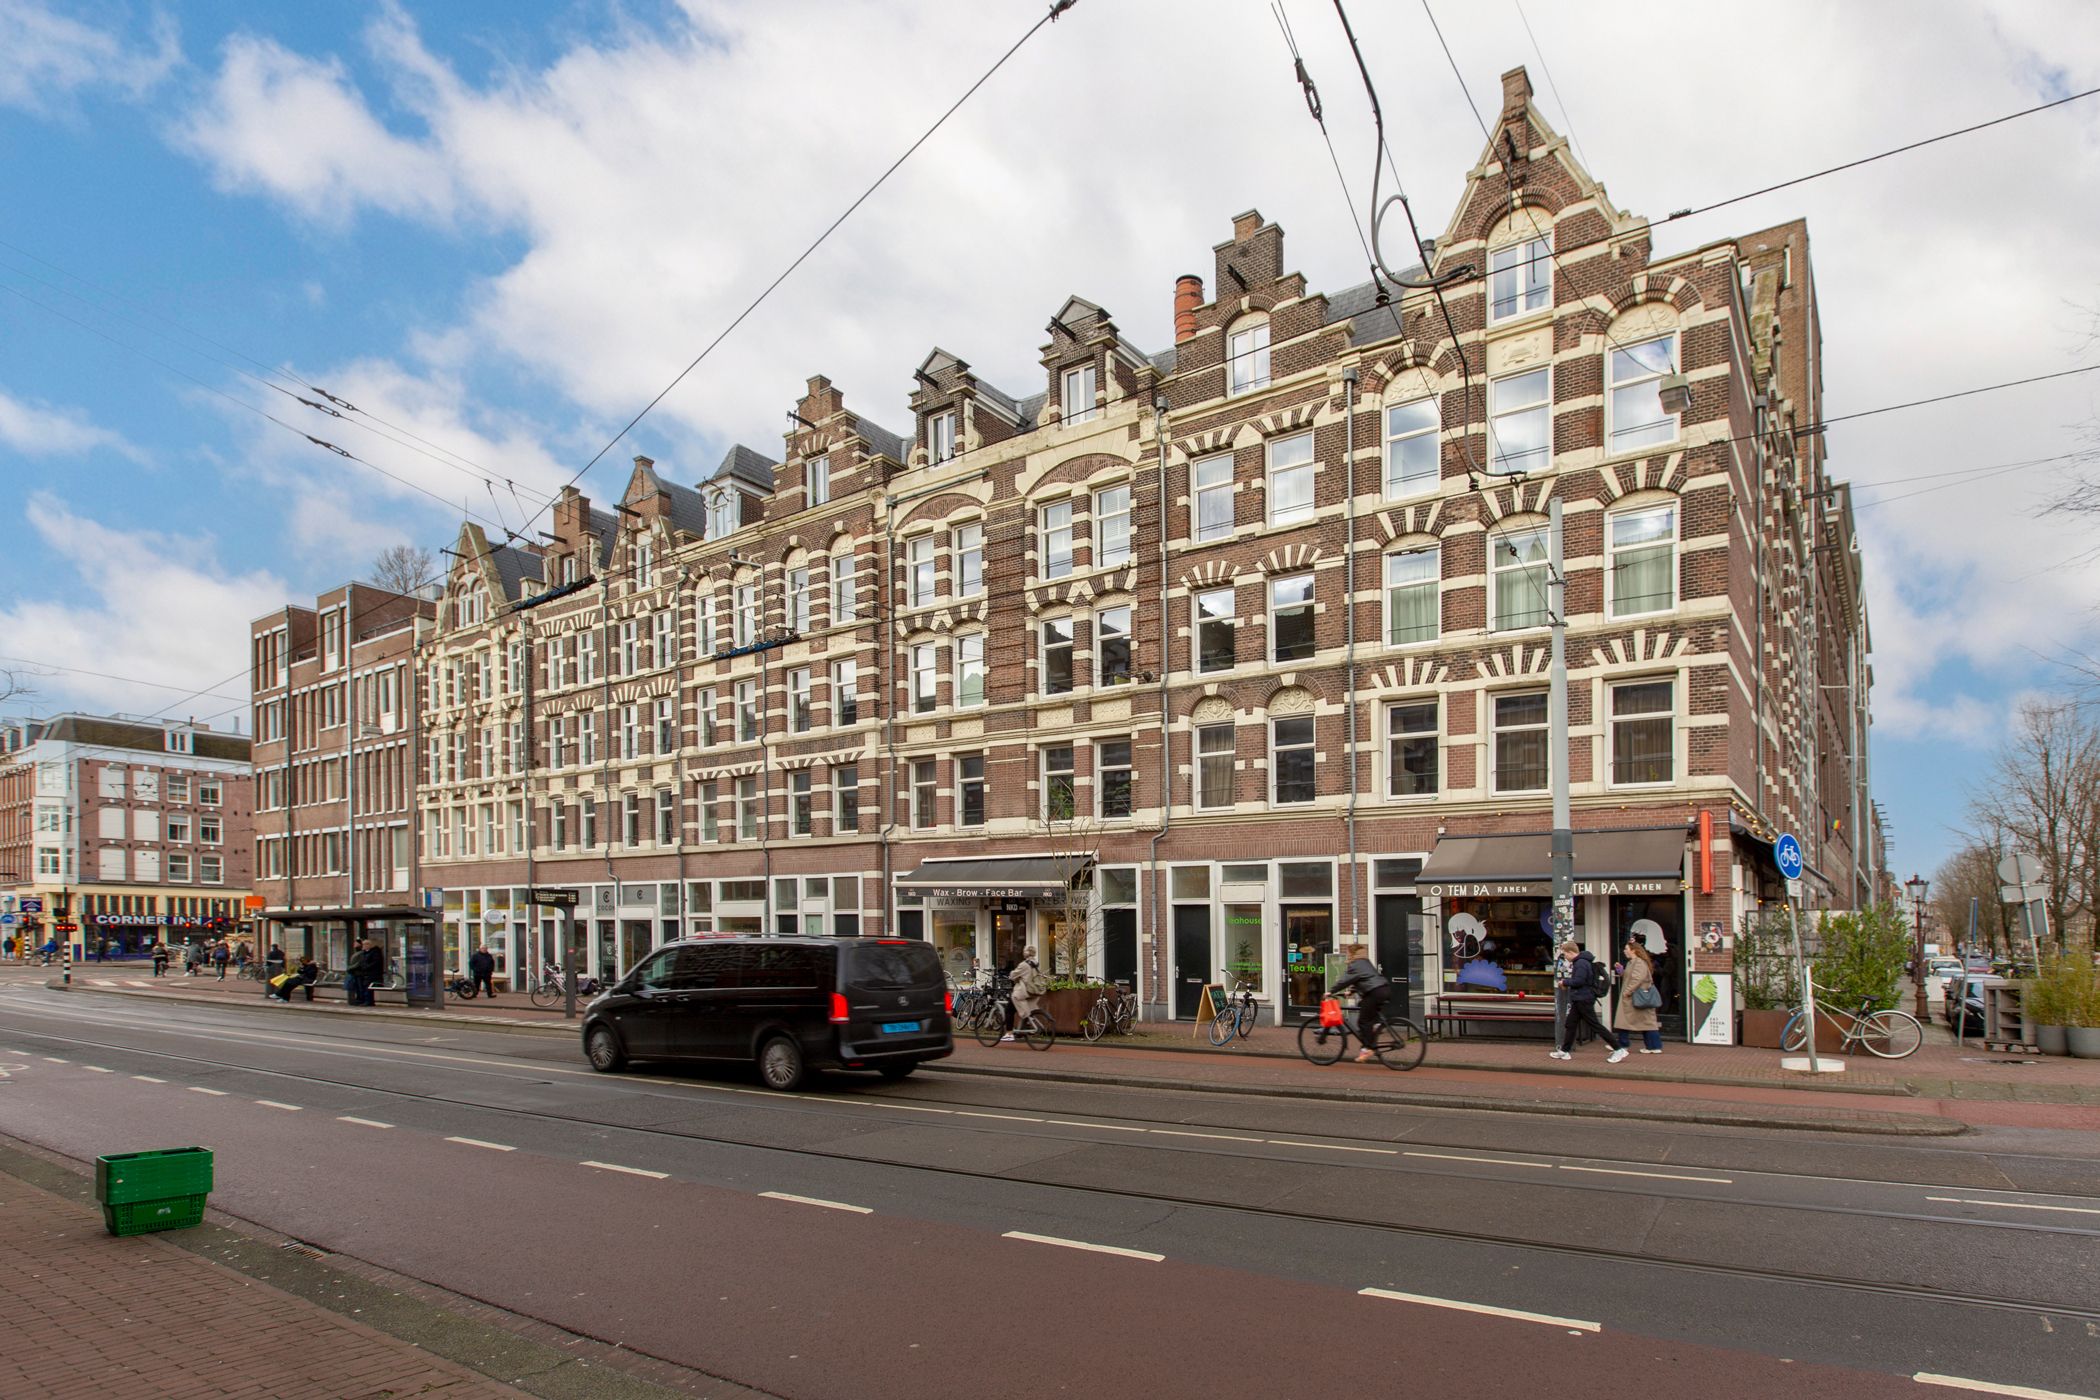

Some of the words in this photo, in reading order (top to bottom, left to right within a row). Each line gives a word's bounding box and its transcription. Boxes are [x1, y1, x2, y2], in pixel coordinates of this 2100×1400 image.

[933, 888, 949, 896] Wax
[956, 888, 978, 896] Brow
[985, 888, 1006, 896] Face
[1008, 888, 1023, 896] Bar
[1448, 885, 1466, 896] TEM
[1473, 885, 1490, 896] BA
[1573, 883, 1592, 894] TEM
[1601, 882, 1619, 894] BA
[1628, 883, 1661, 891] RAMEN
[936, 898, 971, 906] WAXING
[96, 915, 168, 924] CORNER
[173, 915, 202, 925] INN
[1307, 964, 1316, 972] to
[1318, 966, 1325, 974] g
